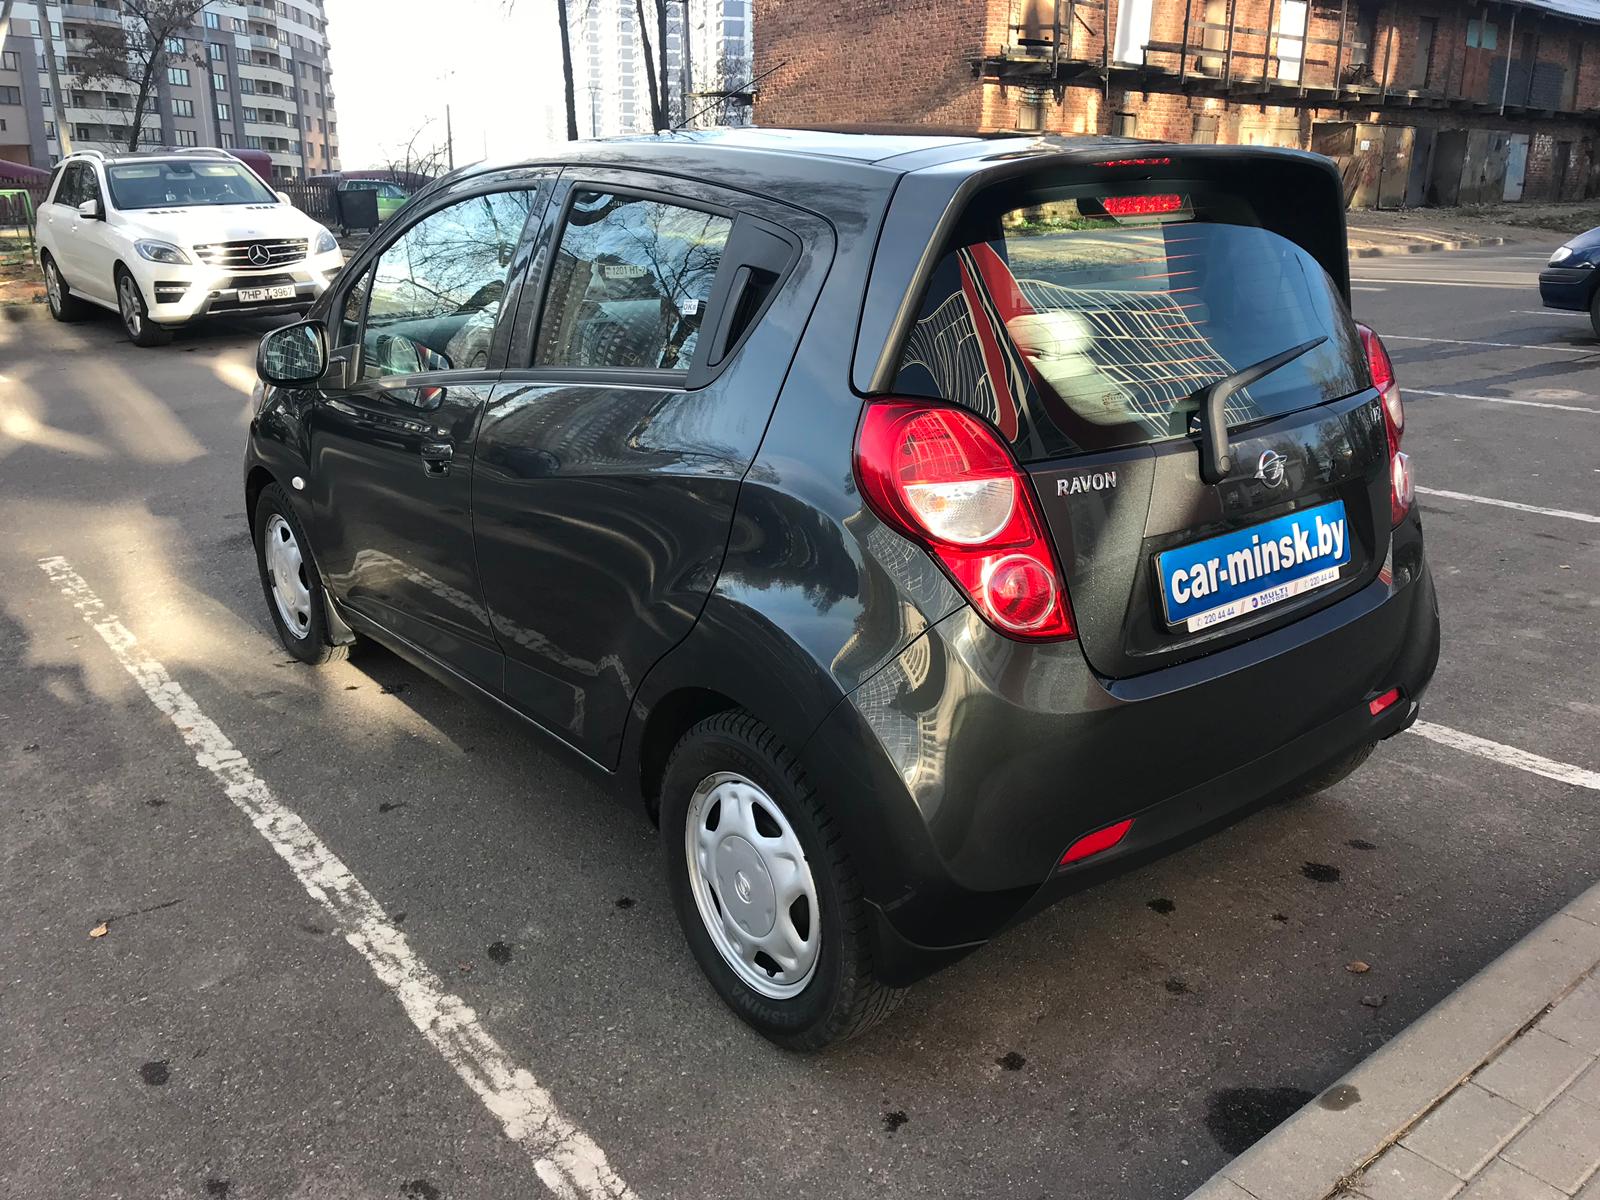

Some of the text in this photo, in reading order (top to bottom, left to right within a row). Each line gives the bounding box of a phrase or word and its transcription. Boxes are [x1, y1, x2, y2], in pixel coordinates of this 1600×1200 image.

[1056, 471, 1117, 497] RAVON
[1171, 515, 1345, 604] car-minsk.by
[1260, 587, 1289, 602] MULTI
